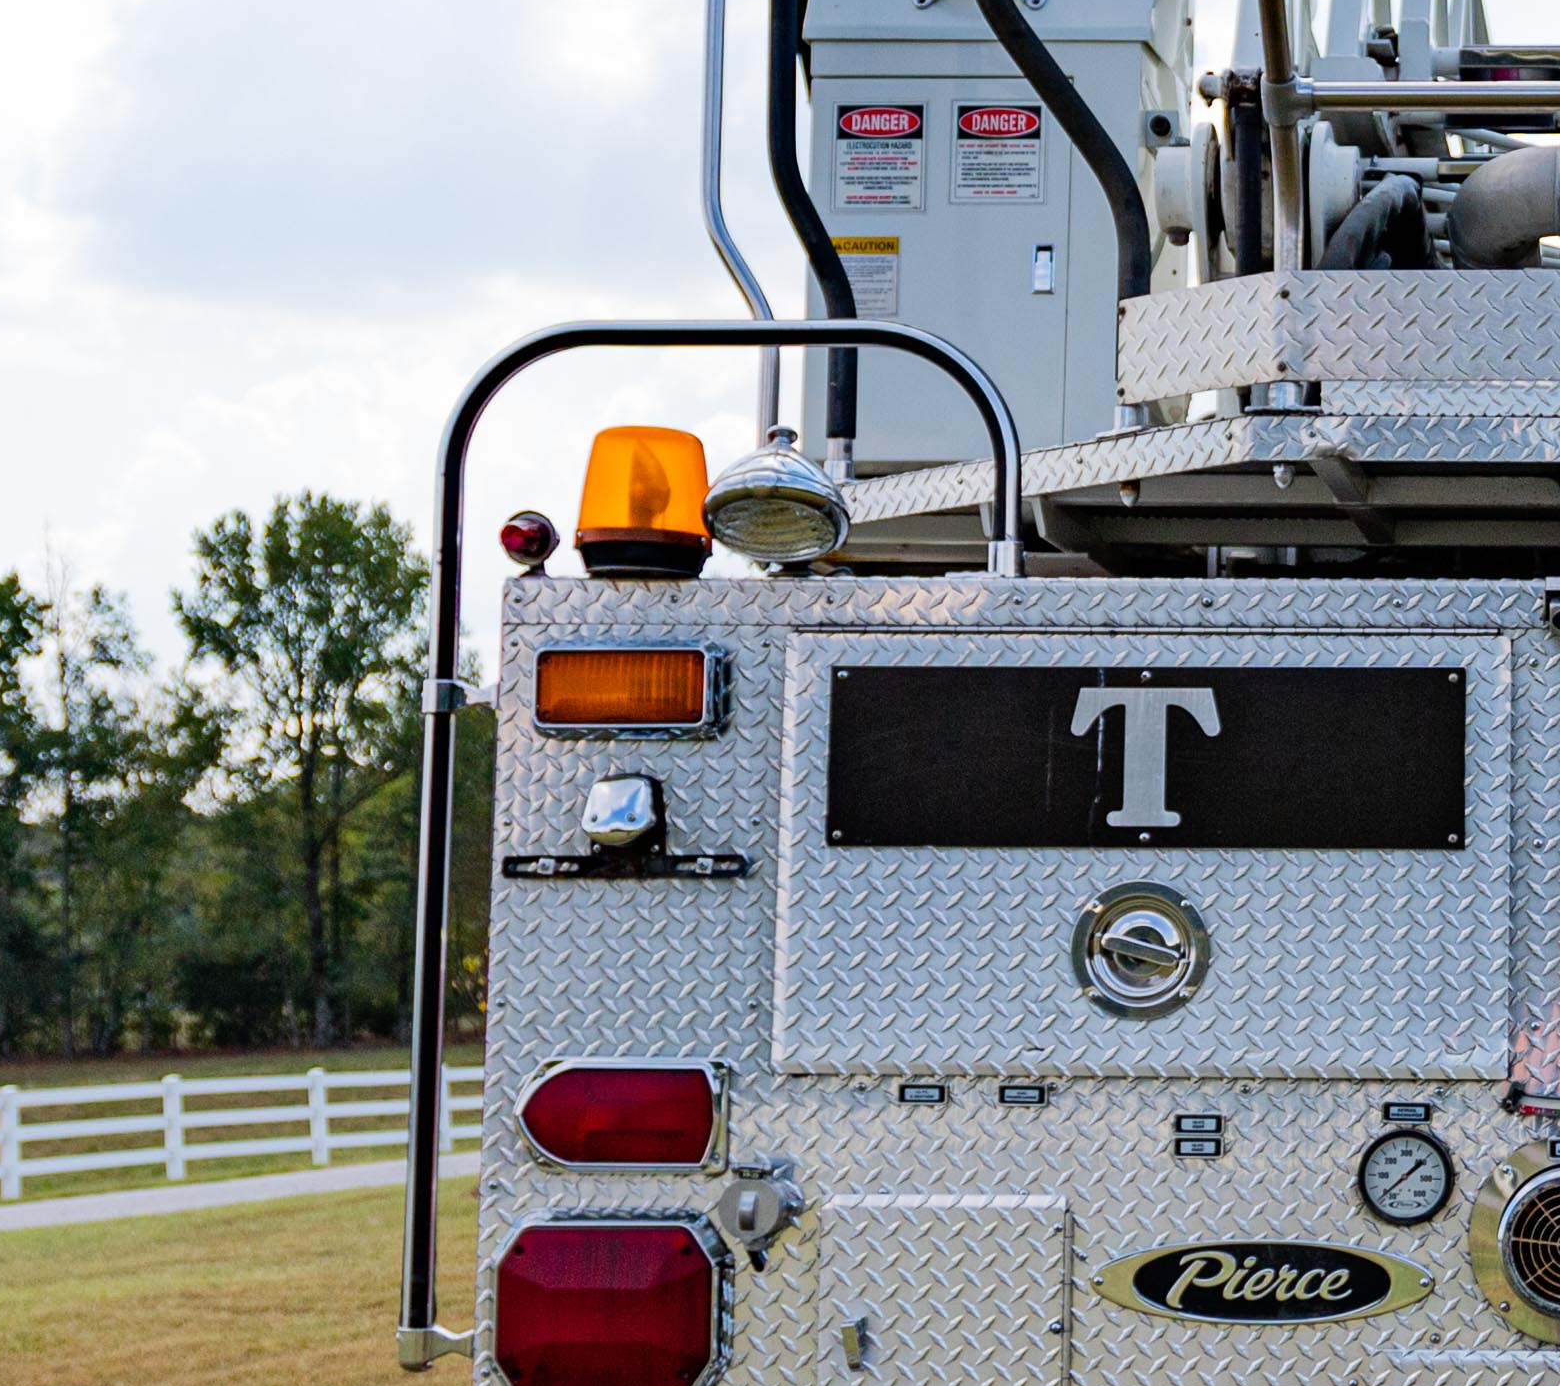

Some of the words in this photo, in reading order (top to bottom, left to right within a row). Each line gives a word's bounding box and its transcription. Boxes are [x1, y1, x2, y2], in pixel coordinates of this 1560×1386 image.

[851, 114, 909, 131] DANGER
[971, 114, 1027, 131] DANGER
[843, 241, 895, 251] CAUTION
[1070, 687, 1221, 827] T
[1384, 1157, 1397, 1165] 200
[1400, 1149, 1413, 1157] 300
[1165, 1250, 1353, 1309] Pierce
